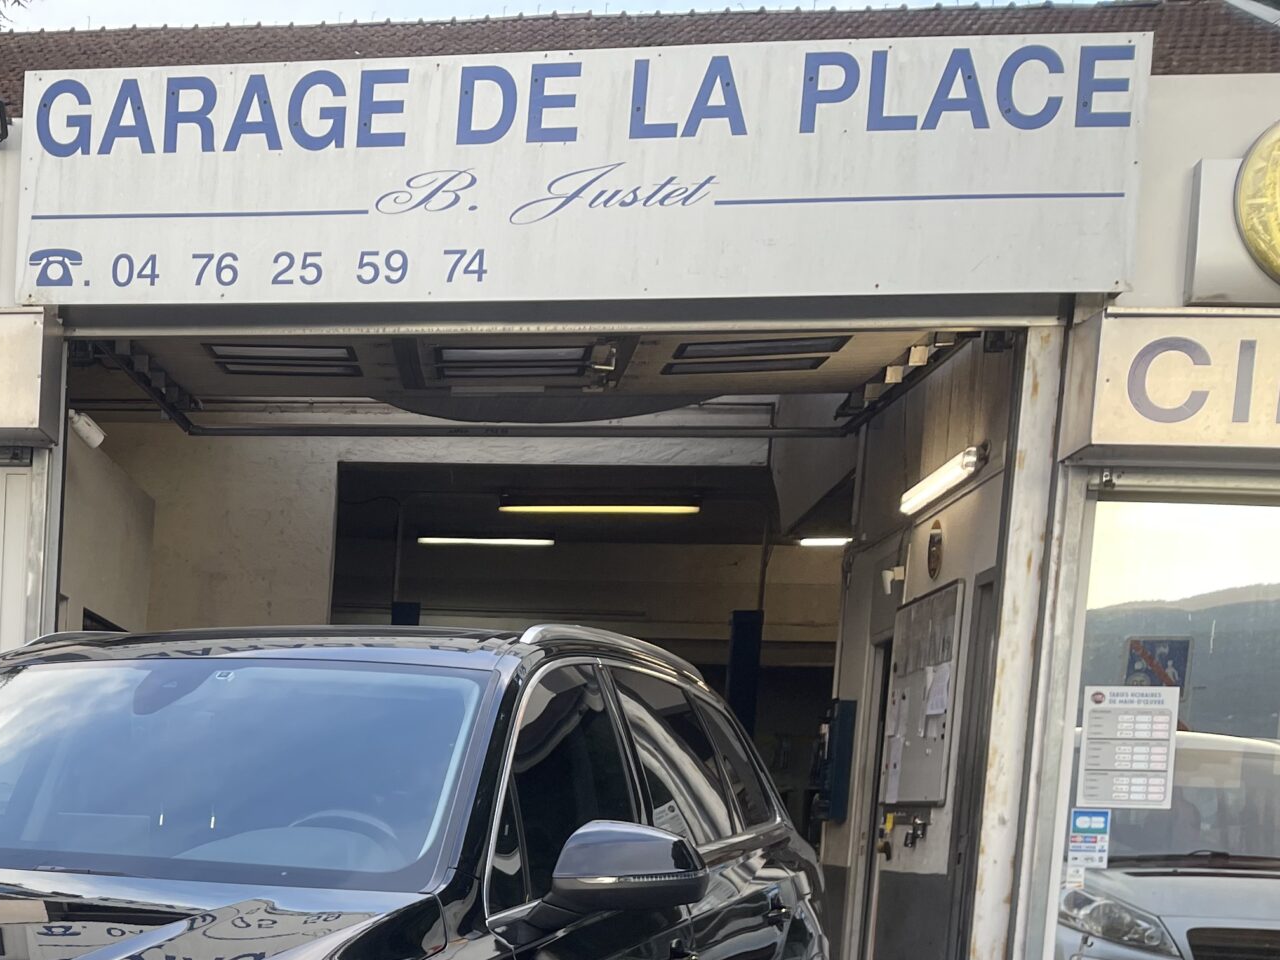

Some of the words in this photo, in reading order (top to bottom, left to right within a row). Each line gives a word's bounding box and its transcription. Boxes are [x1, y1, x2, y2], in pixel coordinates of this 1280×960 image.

[36, 69, 410, 158] GARAGE
[456, 62, 582, 145] DE
[629, 55, 748, 139] LA
[799, 44, 1135, 133] PLACE
[375, 167, 477, 215] B.
[510, 161, 718, 224] Justet
[111, 253, 160, 286] 04
[191, 252, 239, 286] 76
[271, 251, 323, 285] 25
[356, 249, 409, 285] 59
[443, 248, 488, 284] 74
[1127, 336, 1280, 424] CI
